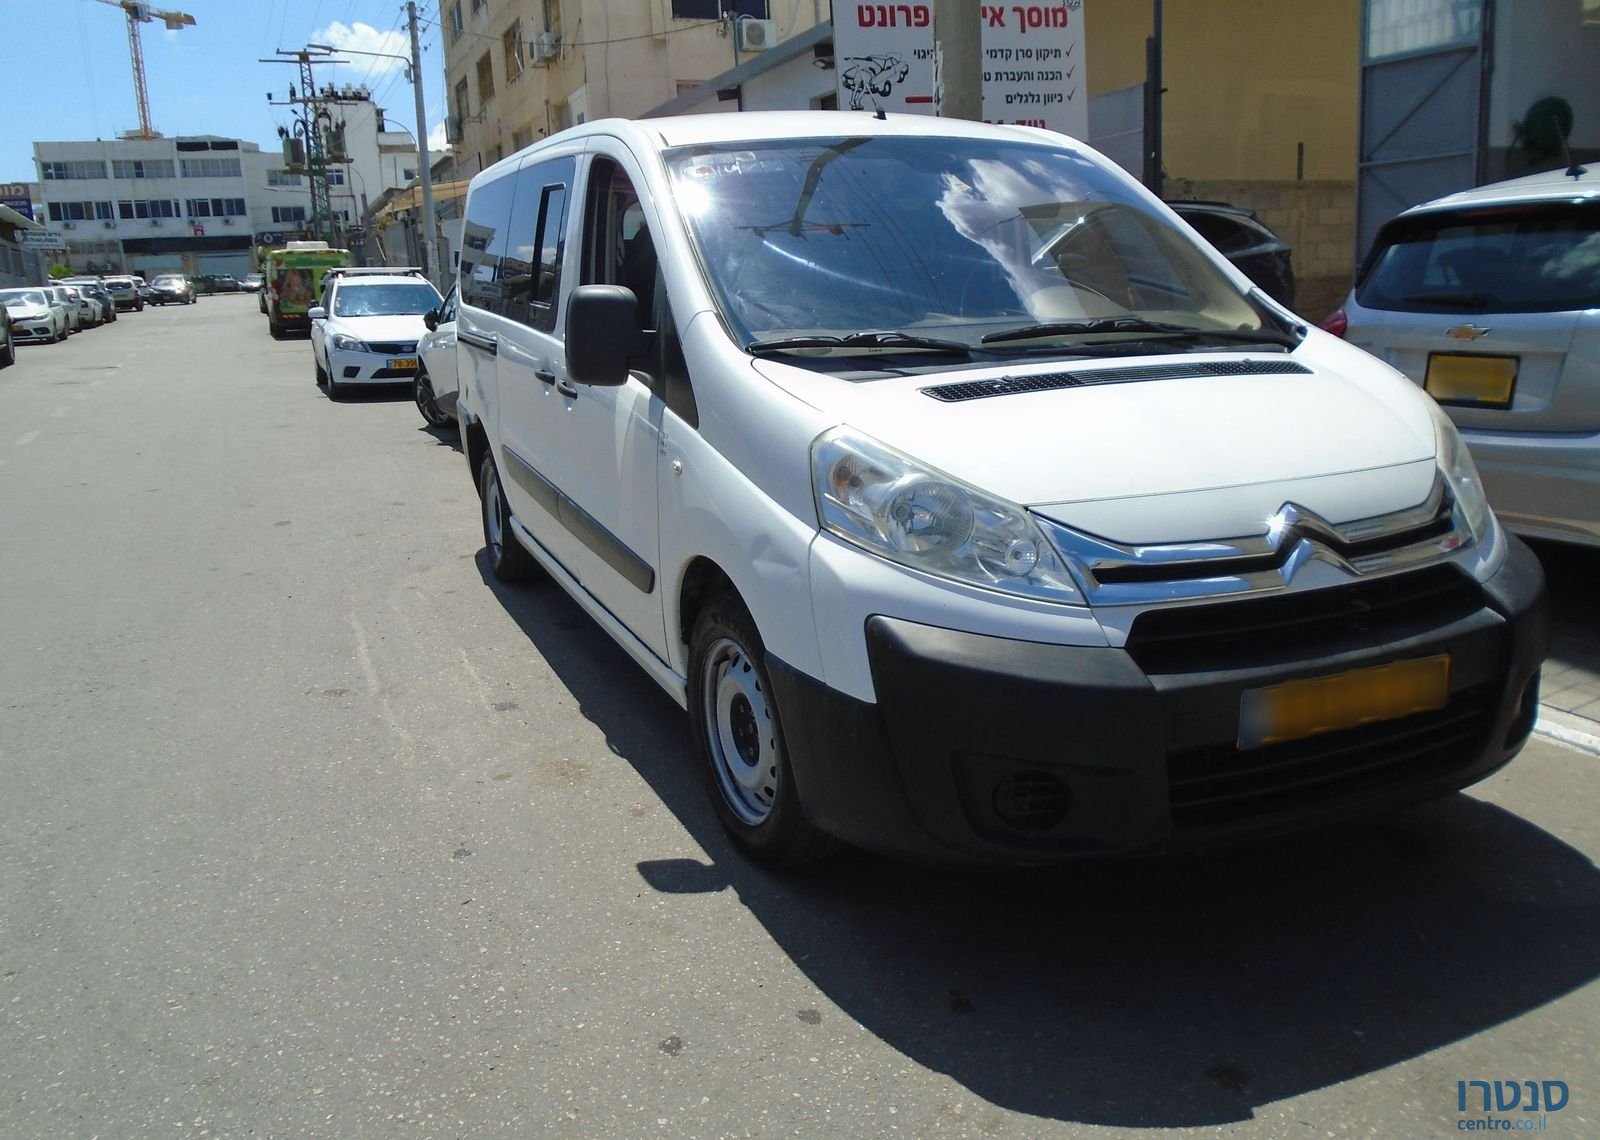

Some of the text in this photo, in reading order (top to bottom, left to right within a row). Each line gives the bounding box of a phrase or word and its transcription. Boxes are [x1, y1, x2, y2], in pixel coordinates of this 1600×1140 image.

[857, 5, 930, 27] פרונט
[1013, 6, 1068, 32] מוסך
[986, 48, 1012, 61] קדמי
[1015, 48, 1033, 61] סרן
[1036, 48, 1062, 61] תיקון
[994, 70, 1034, 81] והעברת
[1037, 70, 1062, 81] הכנה
[1005, 92, 1063, 106] כיוון גלגלים
